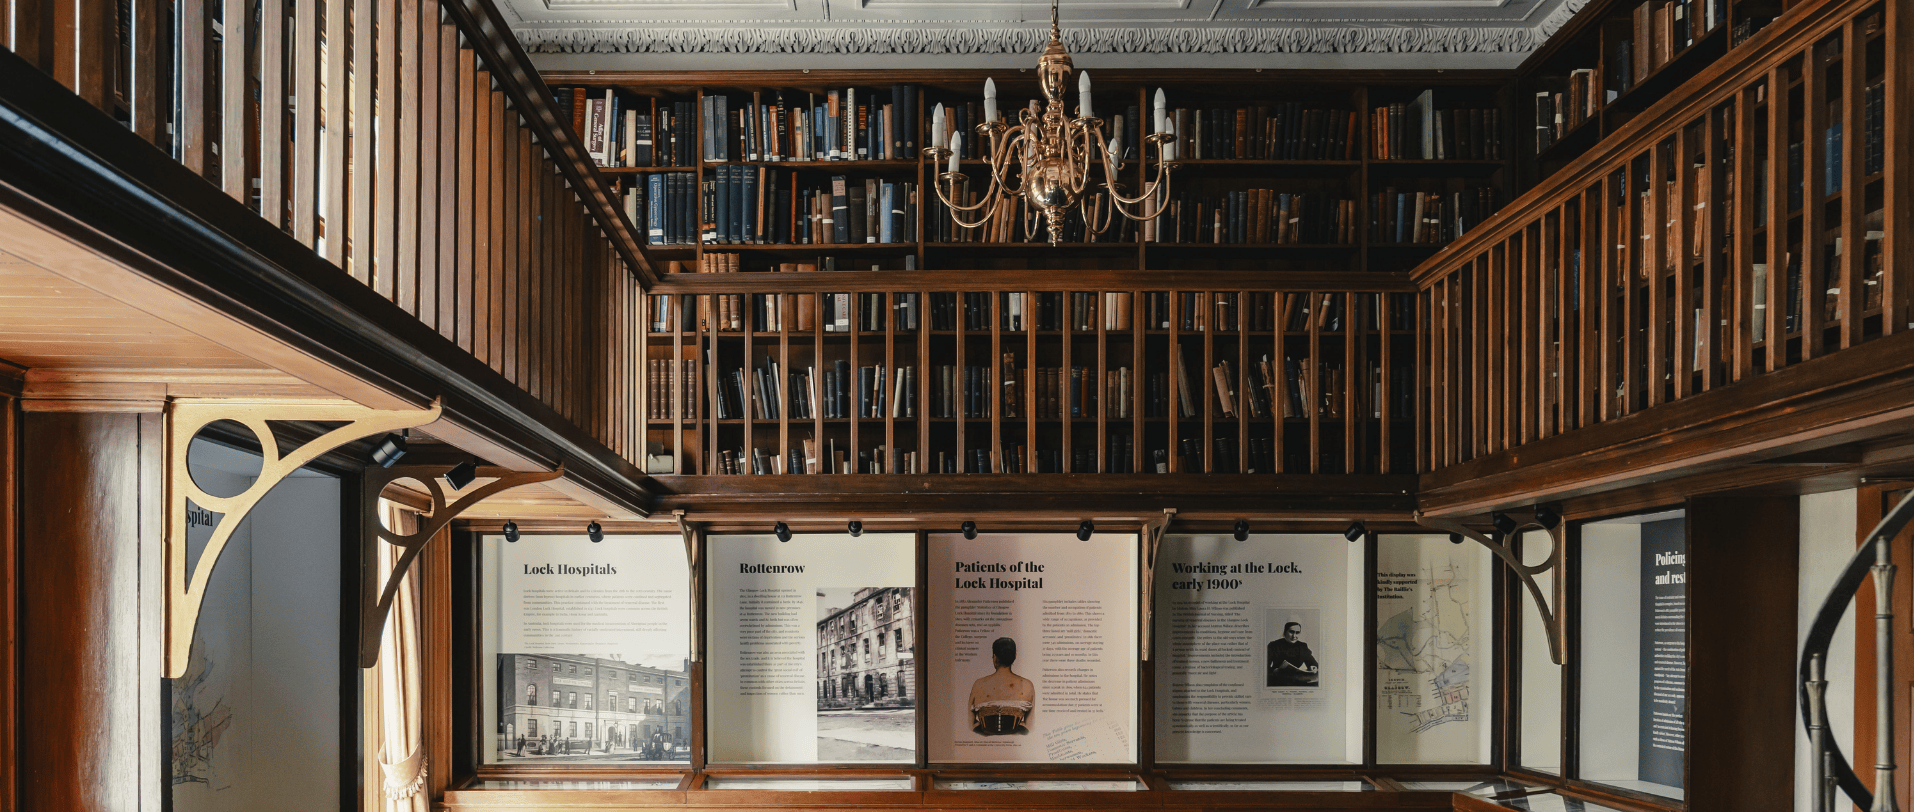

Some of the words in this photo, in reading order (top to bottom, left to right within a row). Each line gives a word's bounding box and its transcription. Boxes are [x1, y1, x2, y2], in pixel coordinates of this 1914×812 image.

[523, 563, 554, 575] Lock
[558, 563, 617, 577] Hospitals
[740, 563, 805, 574] Rottenrow
[955, 561, 1007, 573] Patients
[1009, 561, 1024, 573] of
[1025, 561, 1045, 573] the
[1172, 562, 1228, 576] Working
[1230, 563, 1242, 574] at
[1245, 562, 1265, 574] the
[1268, 562, 1302, 576] Lock,
[955, 577, 986, 589] Lock
[989, 577, 1043, 591] Hospital
[1172, 578, 1204, 592] early
[1655, 571, 1670, 585] and
